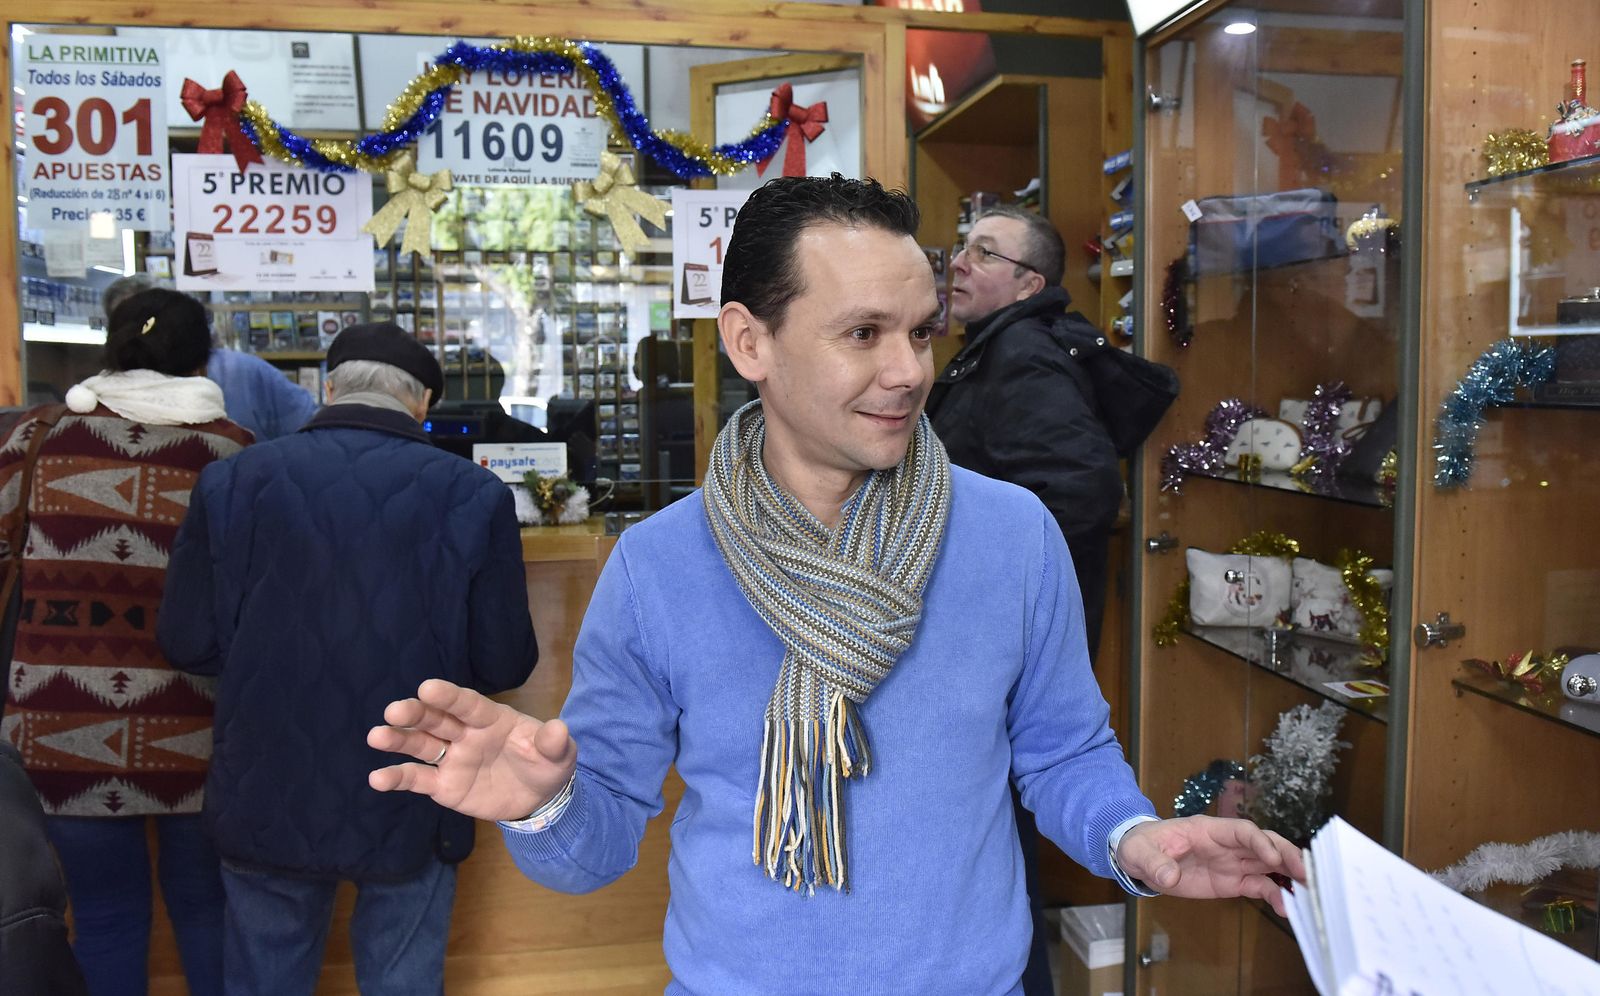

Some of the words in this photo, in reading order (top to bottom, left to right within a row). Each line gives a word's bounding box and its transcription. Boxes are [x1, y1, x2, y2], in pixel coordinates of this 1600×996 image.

[28, 45, 53, 61] LA
[60, 46, 159, 63] PRIMITIVA
[28, 69, 69, 85] Todos
[75, 70, 96, 86] los
[101, 71, 162, 88] Sábados
[487, 70, 588, 89] LOTERI
[473, 91, 599, 118] NAVIDAD
[32, 97, 152, 155] 301
[426, 119, 564, 162] 11609
[33, 163, 162, 181] APUESTAS
[484, 175, 499, 185] DE
[503, 173, 531, 186] AQUÍ
[533, 177, 548, 186] LA
[231, 173, 345, 195] PREMIO
[91, 189, 104, 199] de
[135, 190, 141, 199] 4
[136, 208, 146, 221] €
[213, 205, 337, 234] 22259
